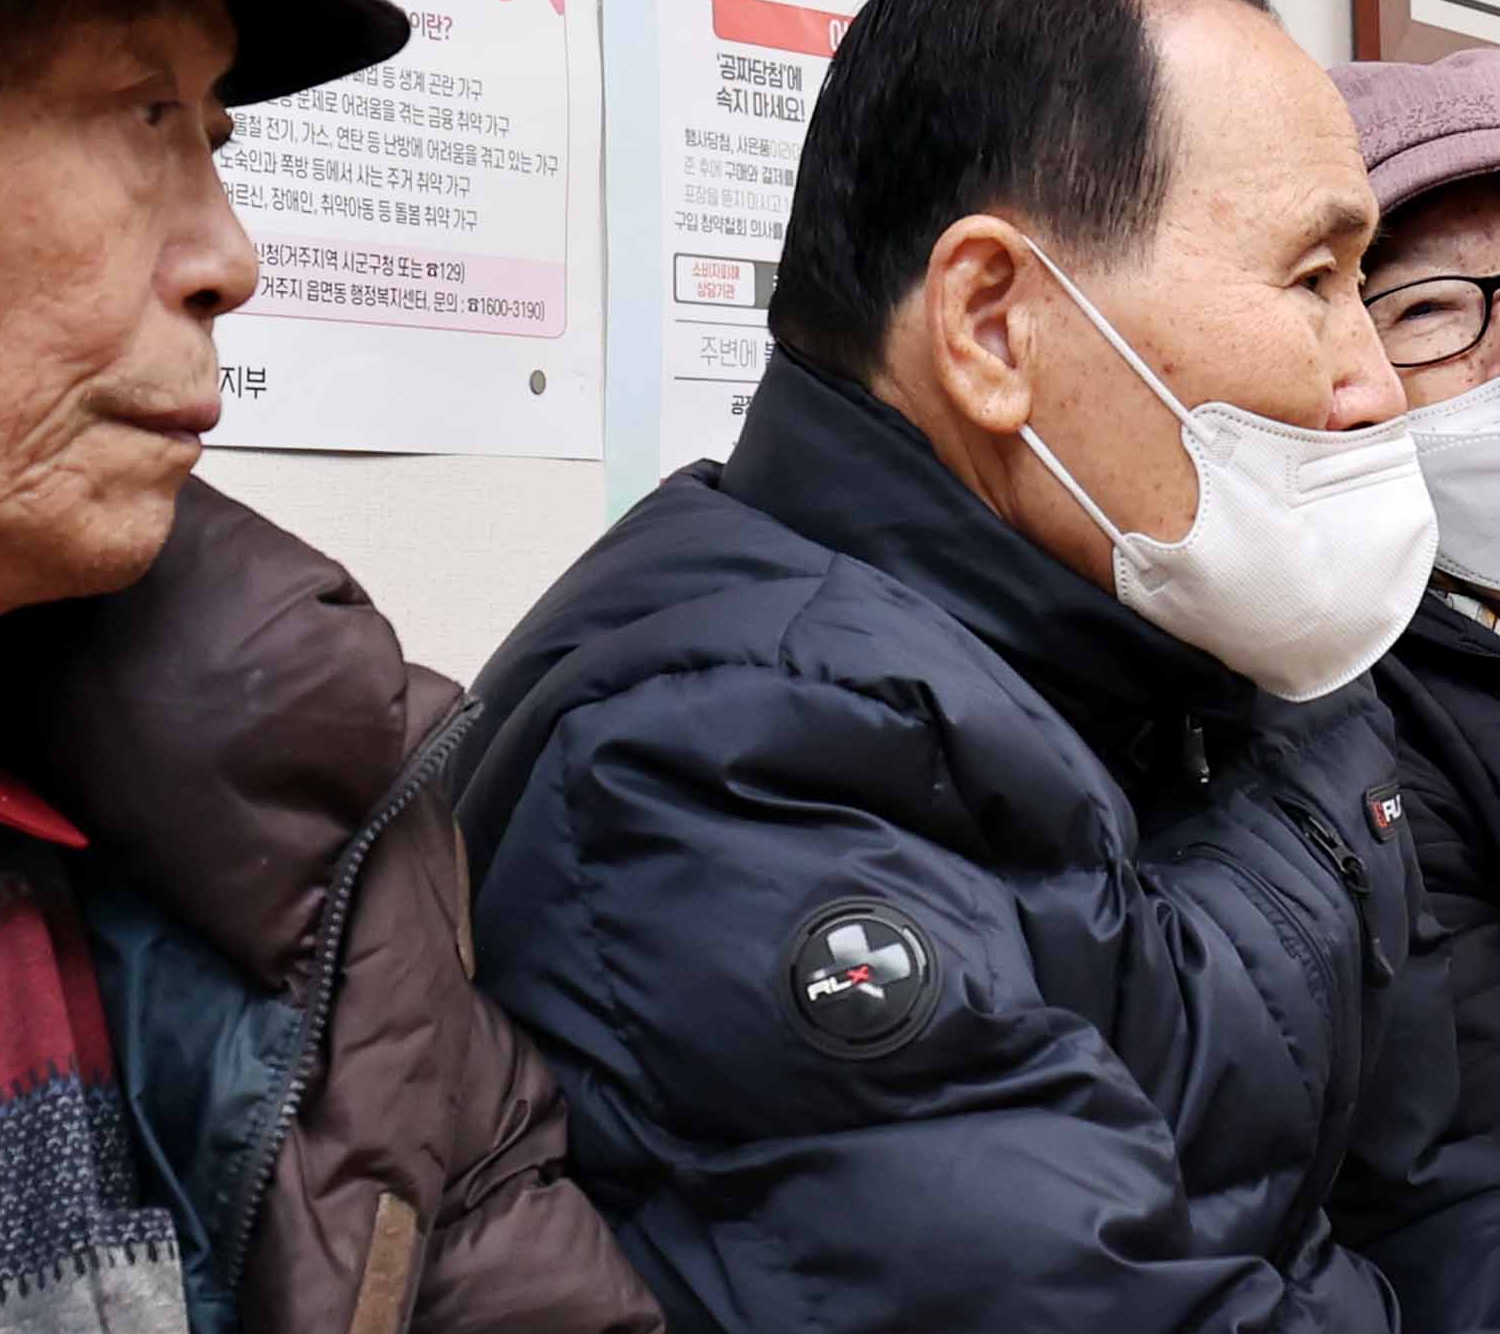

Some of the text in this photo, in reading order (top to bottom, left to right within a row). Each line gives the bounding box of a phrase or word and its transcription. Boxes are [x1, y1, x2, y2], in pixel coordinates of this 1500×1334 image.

[342, 92, 395, 123] 어려움을
[716, 87, 805, 124] 속지 마세요!
[384, 132, 477, 167] 난방에 어려움을
[220, 148, 471, 198] 노숙인과 등에서 사는 주거 취약 가구
[321, 193, 478, 233] 취약아동 취약 가구
[342, 250, 394, 277] 시군구청
[261, 275, 347, 304] 거주지 읍면동
[700, 336, 757, 370] 주변에
